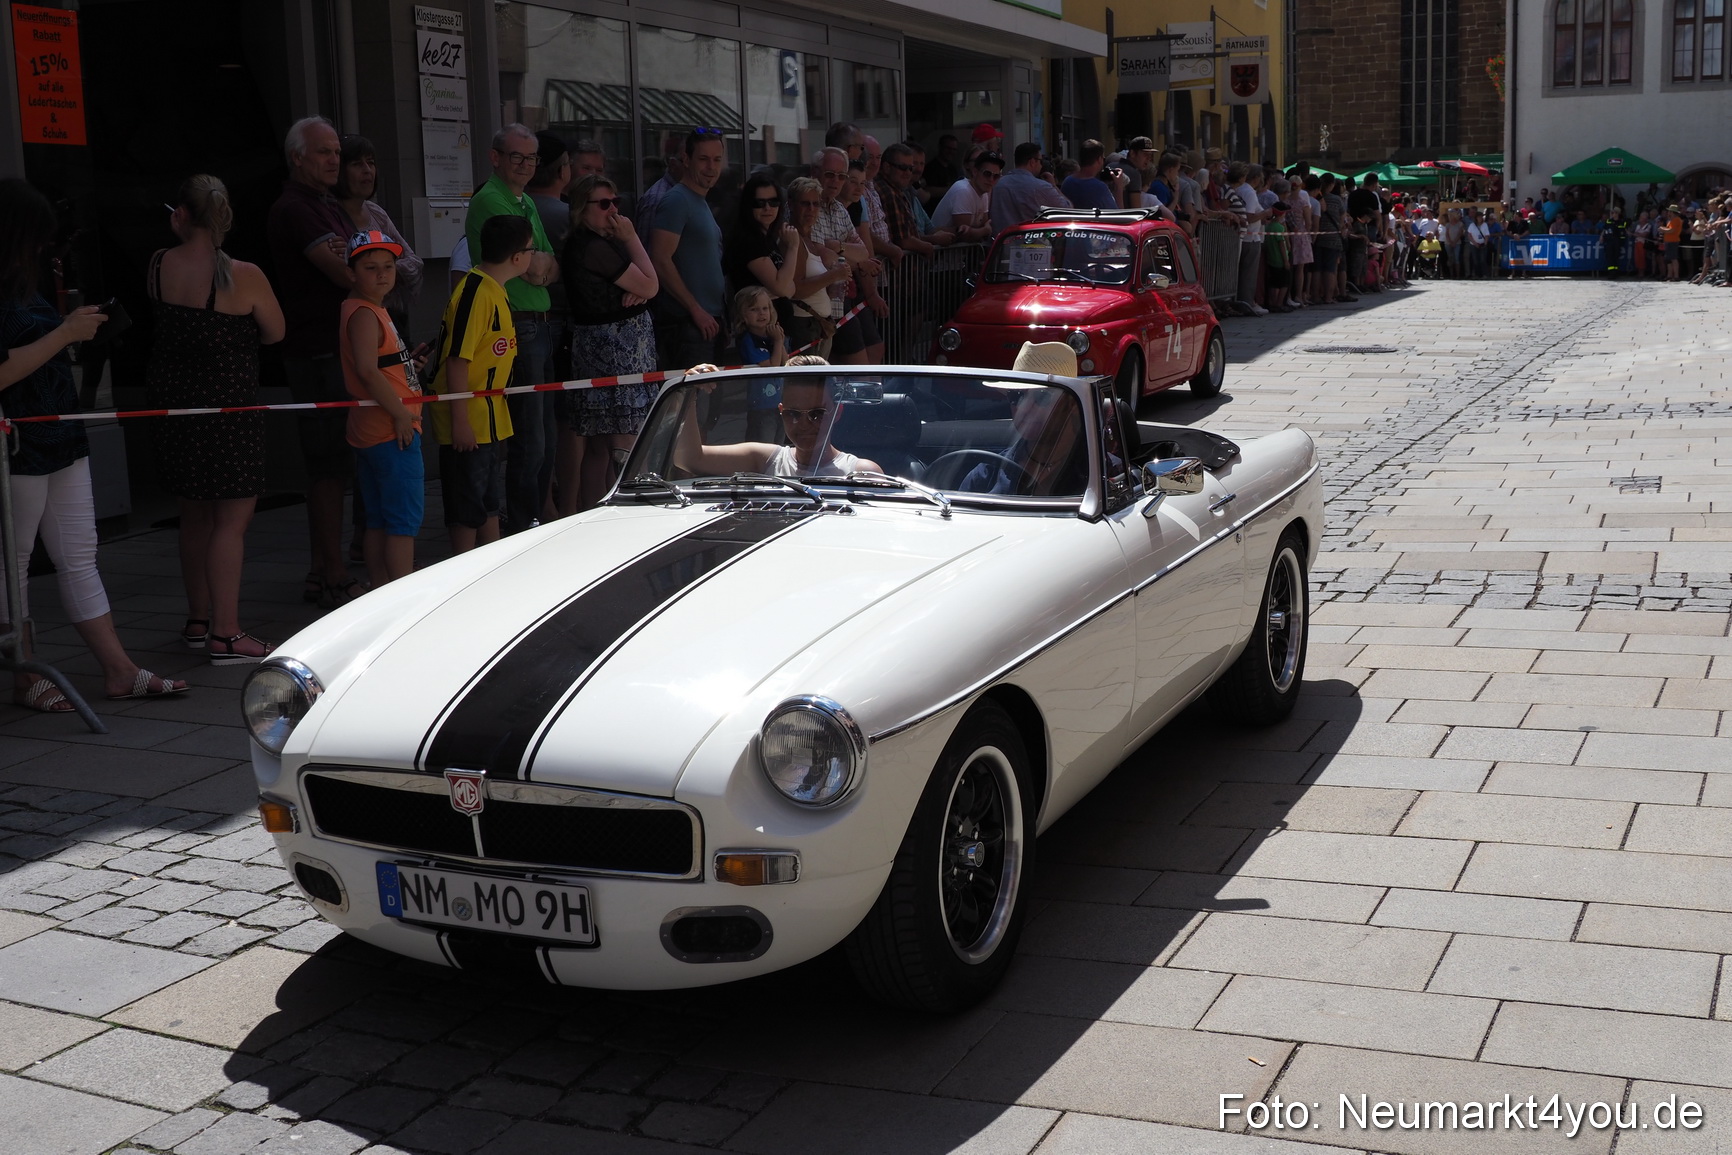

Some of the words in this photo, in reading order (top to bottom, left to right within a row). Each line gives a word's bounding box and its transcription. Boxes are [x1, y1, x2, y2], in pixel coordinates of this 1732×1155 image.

[17, 9, 74, 27] Neueröffnungs-
[416, 8, 454, 27] Klostergasse
[455, 14, 462, 27] 27
[33, 29, 62, 42] Rabatt
[1226, 41, 1258, 49] RATHAUS
[1259, 40, 1265, 48] II
[421, 37, 462, 69] ke27
[30, 52, 68, 77] 15%
[1120, 58, 1156, 71] SARAH
[1158, 56, 1166, 69] K
[39, 80, 50, 92] auf
[52, 81, 64, 93] alle
[28, 95, 77, 109] Ledertaschen
[50, 112, 57, 123] &
[42, 127, 68, 139] Schuhe
[1024, 231, 1043, 240] Fiat
[1064, 231, 1087, 239] Club
[1088, 232, 1117, 243] Italia
[1029, 253, 1044, 262] 107
[1164, 322, 1182, 362] 74
[456, 783, 476, 804] MG
[386, 895, 396, 907] D
[398, 871, 450, 917] NM
[474, 881, 526, 926] MO
[535, 890, 589, 934] 9H
